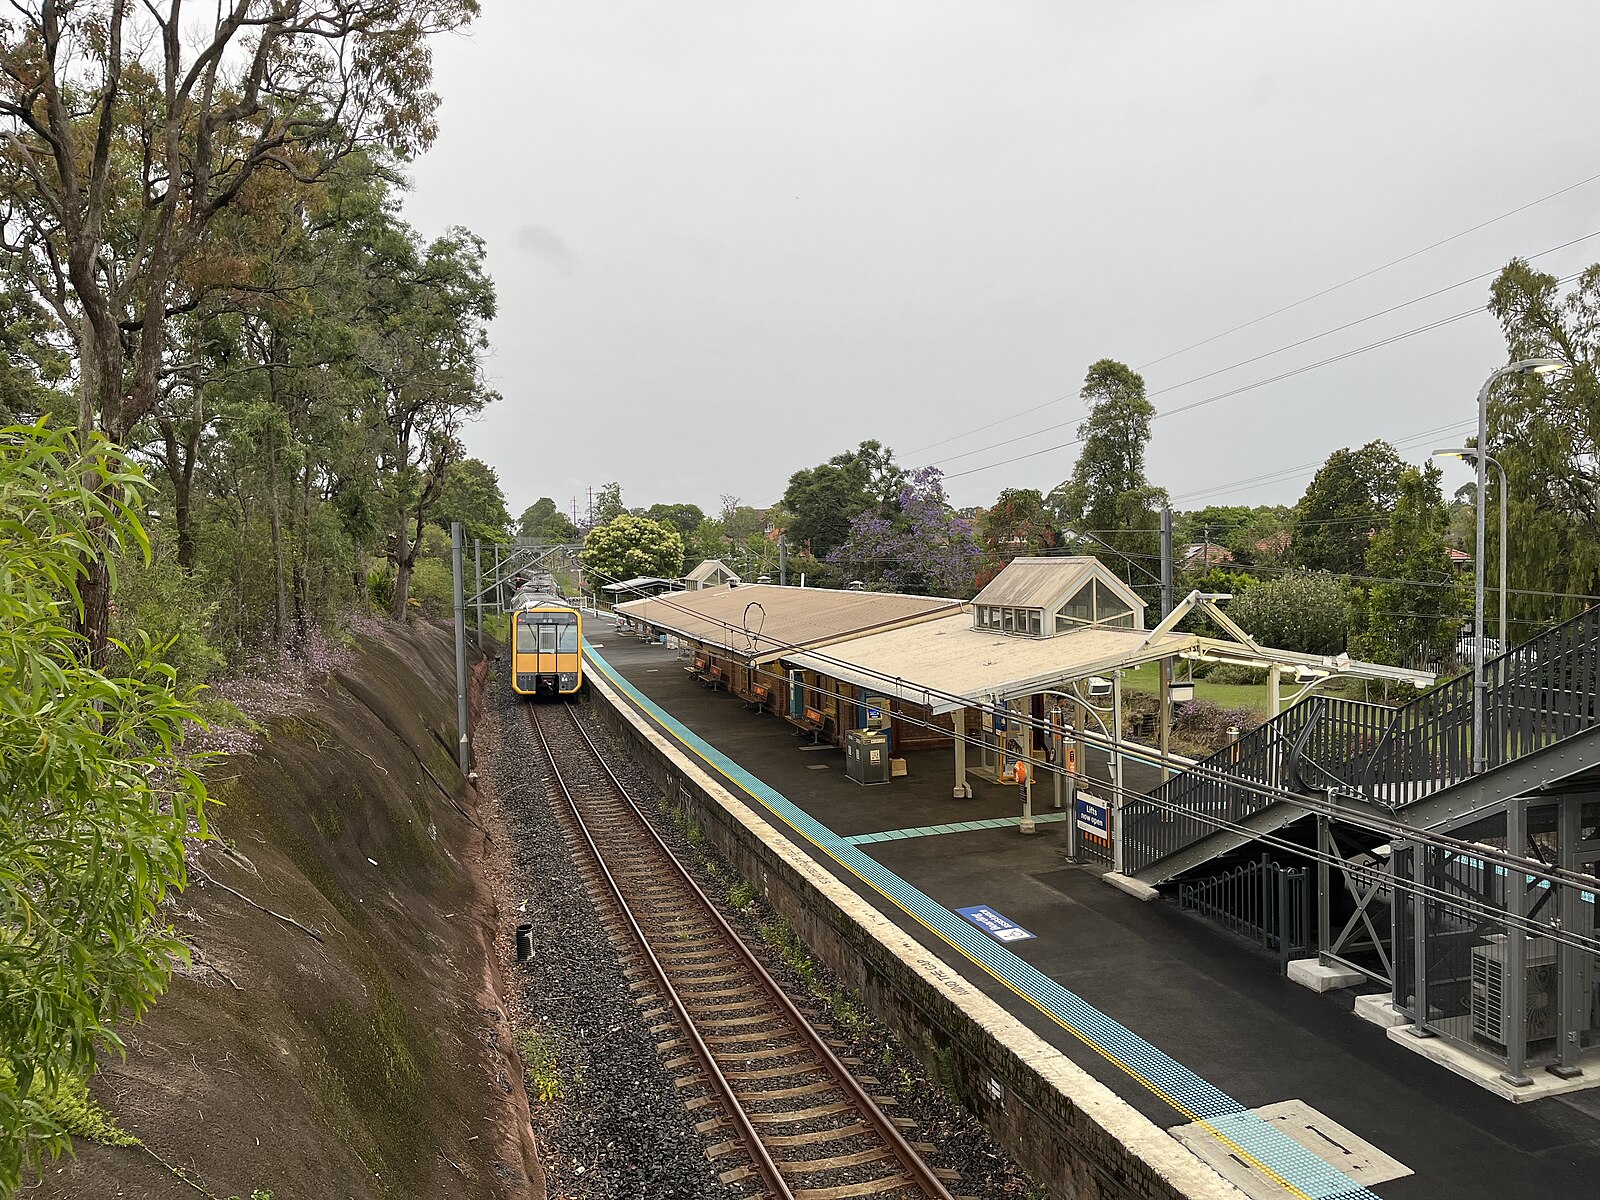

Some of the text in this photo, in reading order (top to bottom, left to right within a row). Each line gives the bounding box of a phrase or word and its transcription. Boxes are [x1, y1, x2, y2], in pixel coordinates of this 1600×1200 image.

[1086, 804, 1098, 816] Lifts
[1080, 812, 1090, 822] now
[1091, 816, 1103, 826] open
